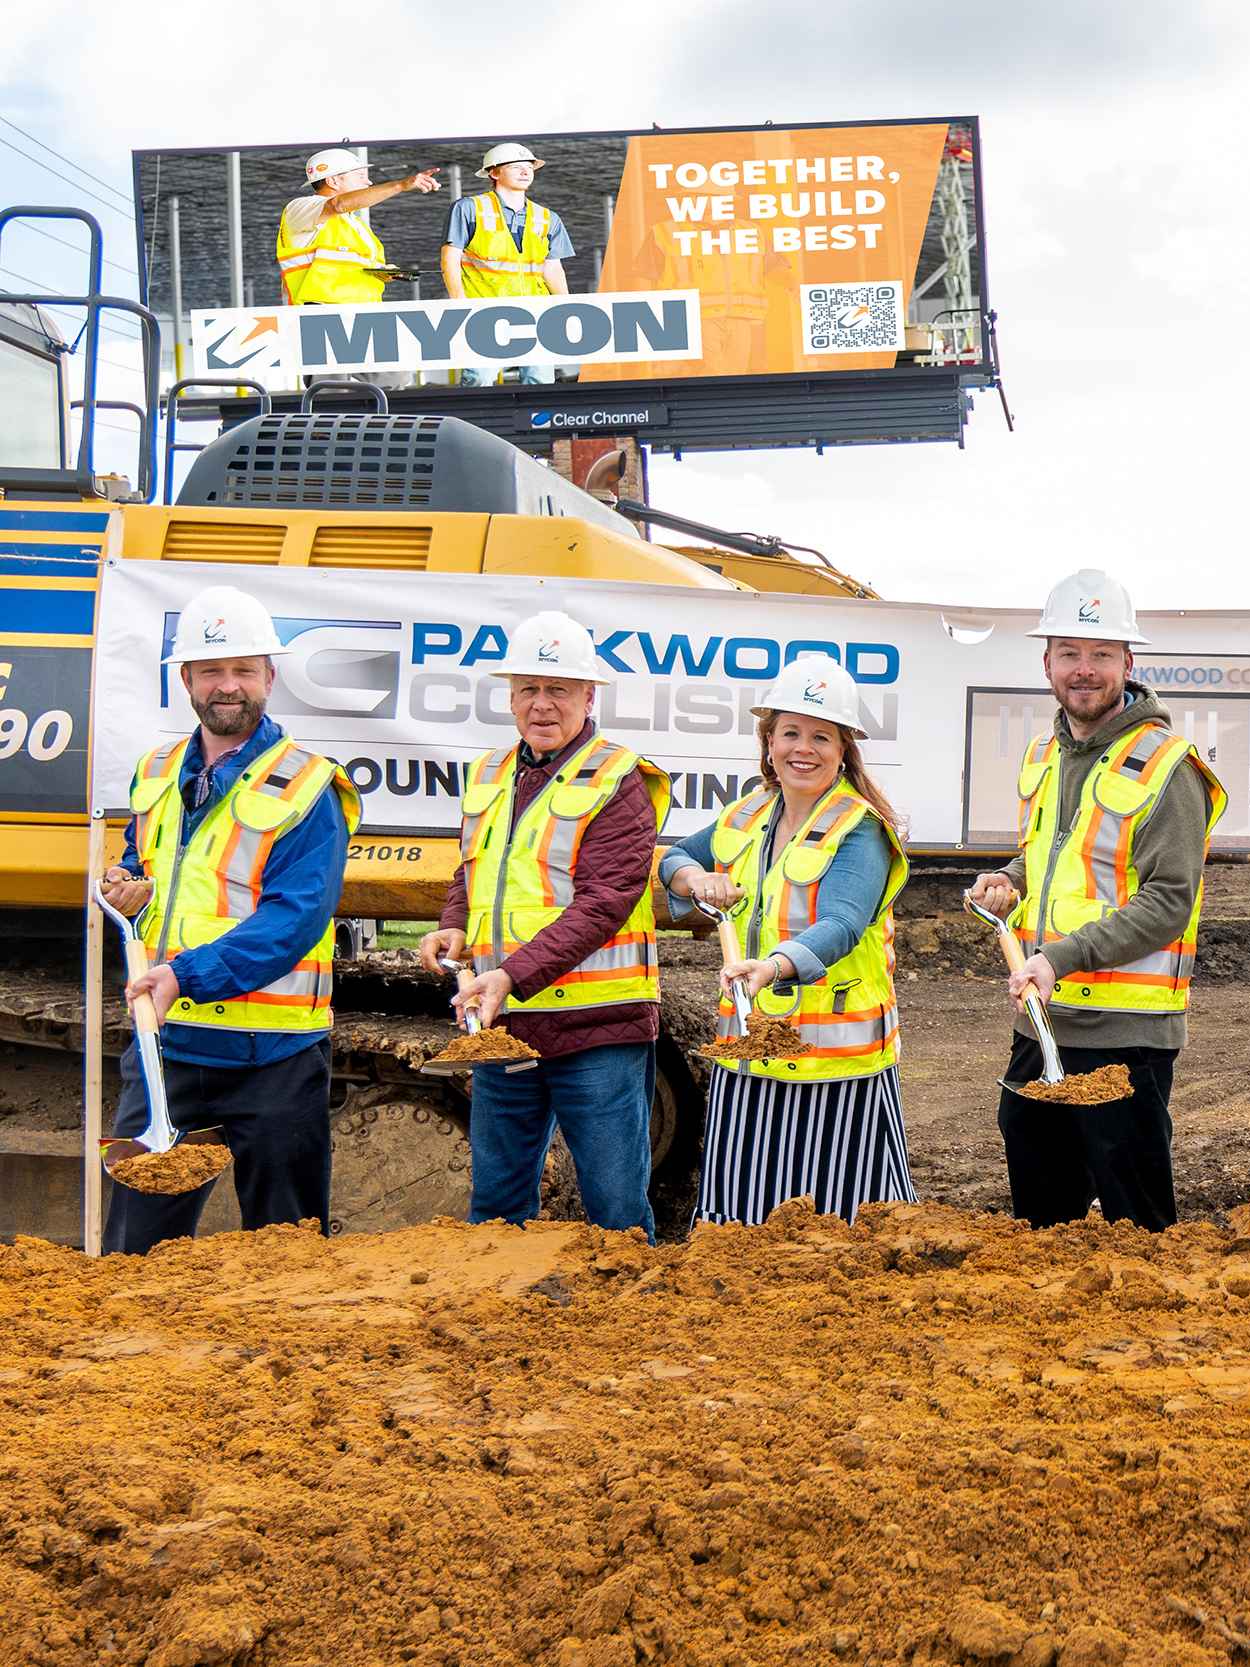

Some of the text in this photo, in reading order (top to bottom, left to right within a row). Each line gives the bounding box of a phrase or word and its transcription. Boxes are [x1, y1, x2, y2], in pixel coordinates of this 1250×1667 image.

[647, 155, 901, 189] TOGETHER,
[665, 189, 887, 222] WE BUILD
[672, 223, 884, 256] THE BEST
[299, 299, 690, 366] MYCON
[552, 409, 649, 426] Clear Channel
[411, 622, 900, 685] PAKWOOD
[1133, 666, 1223, 685] KWOOD
[408, 672, 899, 741] COLISIN
[347, 845, 422, 861] 21018
